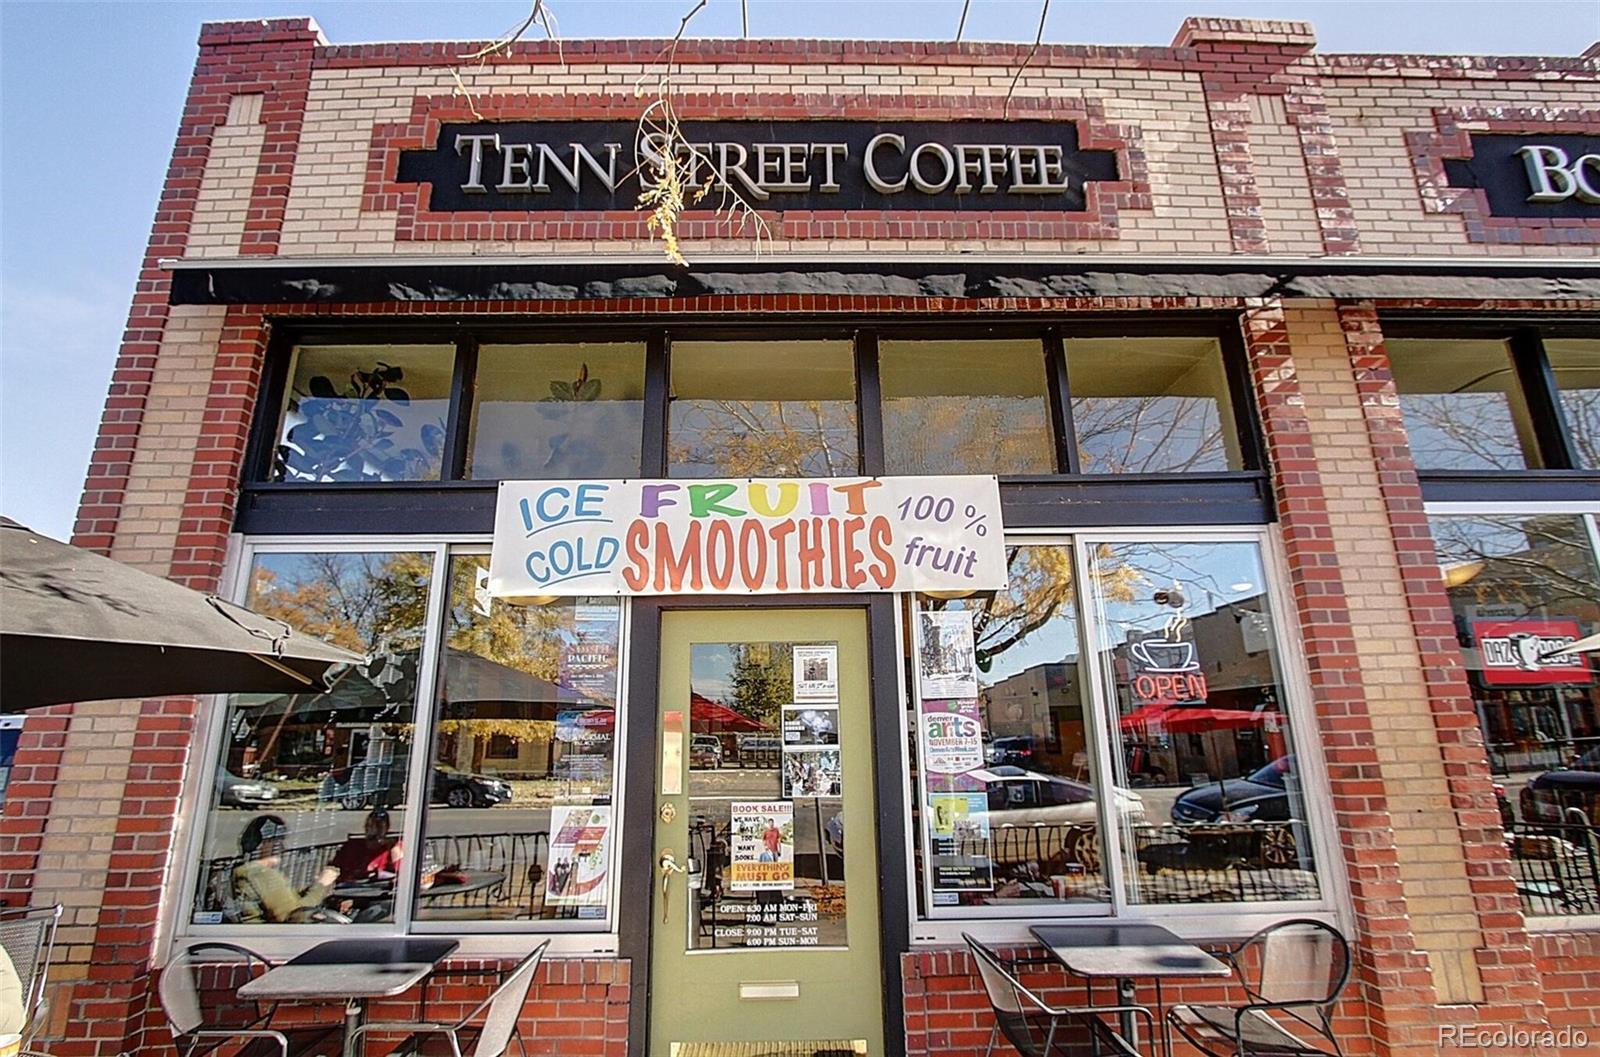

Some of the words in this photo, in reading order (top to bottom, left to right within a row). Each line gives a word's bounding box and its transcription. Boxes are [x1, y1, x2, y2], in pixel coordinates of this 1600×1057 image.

[454, 133, 623, 195] TENN
[638, 132, 849, 199] STREET
[863, 132, 1069, 195] COFFEE
[639, 480, 883, 519] FRUIT
[519, 484, 611, 531] ICE
[897, 494, 955, 522] 100
[965, 505, 988, 537] %
[622, 516, 897, 592] SMOOTHIES
[904, 536, 979, 579] fruit
[525, 536, 621, 583] COLD
[568, 654, 608, 663] PACIFIC
[1136, 674, 1208, 699] OPEN
[927, 715, 953, 723] denver
[928, 717, 976, 738] arts
[929, 738, 963, 746] NOVEMBER
[732, 805, 759, 813] BOOK
[761, 804, 792, 812] SALE!!!
[737, 844, 756, 852] MANY
[736, 863, 790, 872] EVERYTHING
[736, 871, 768, 881] MUST
[772, 872, 790, 881] GO
[746, 904, 761, 913] 6:30
[763, 903, 777, 912] AM
[746, 913, 761, 922] 7:00
[763, 913, 777, 922] AM
[746, 928, 761, 937] 9:00
[763, 928, 777, 936] PM
[746, 938, 761, 946] 6:00
[763, 937, 777, 946] PM
